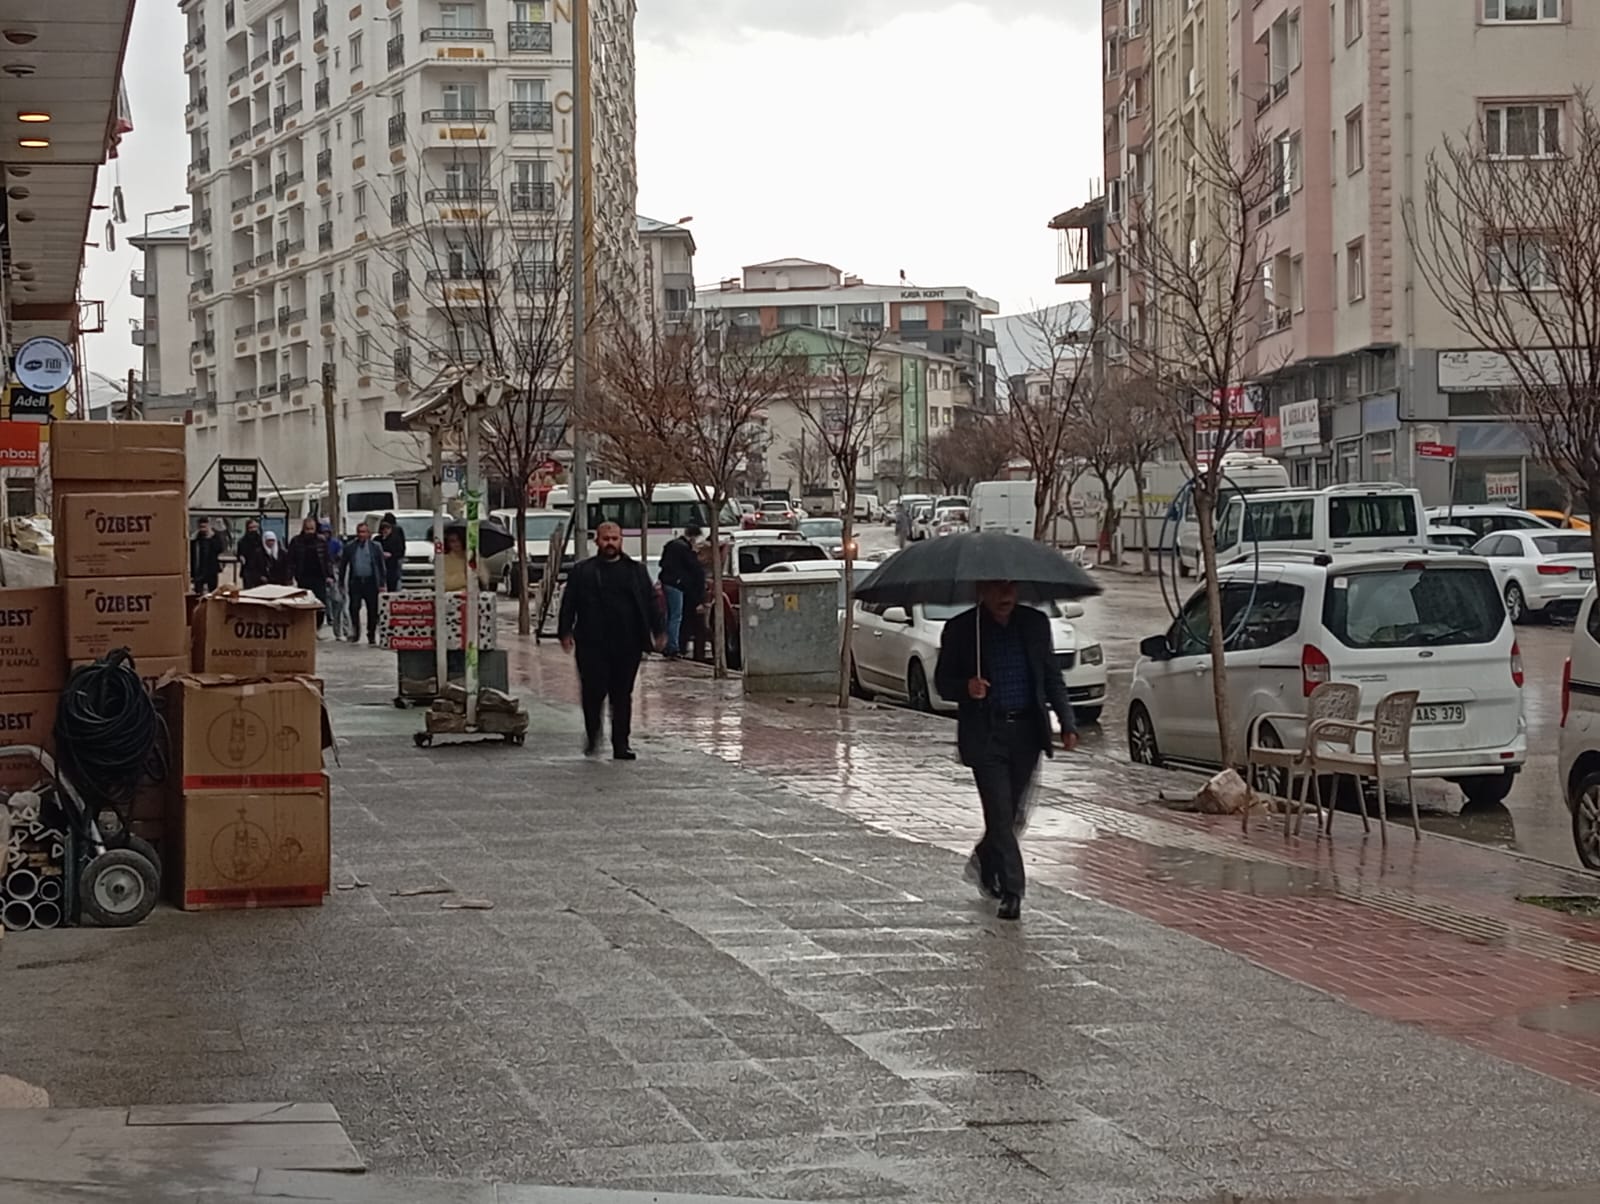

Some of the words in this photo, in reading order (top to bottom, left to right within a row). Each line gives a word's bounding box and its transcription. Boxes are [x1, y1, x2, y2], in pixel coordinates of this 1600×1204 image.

[14, 395, 47, 407] Adell
[95, 511, 153, 534] ÖZBEST
[95, 591, 153, 613] ÖZBEST
[234, 616, 290, 640] ÖZBEST
[1416, 707, 1438, 721] AAS
[1441, 705, 1462, 720] 379
